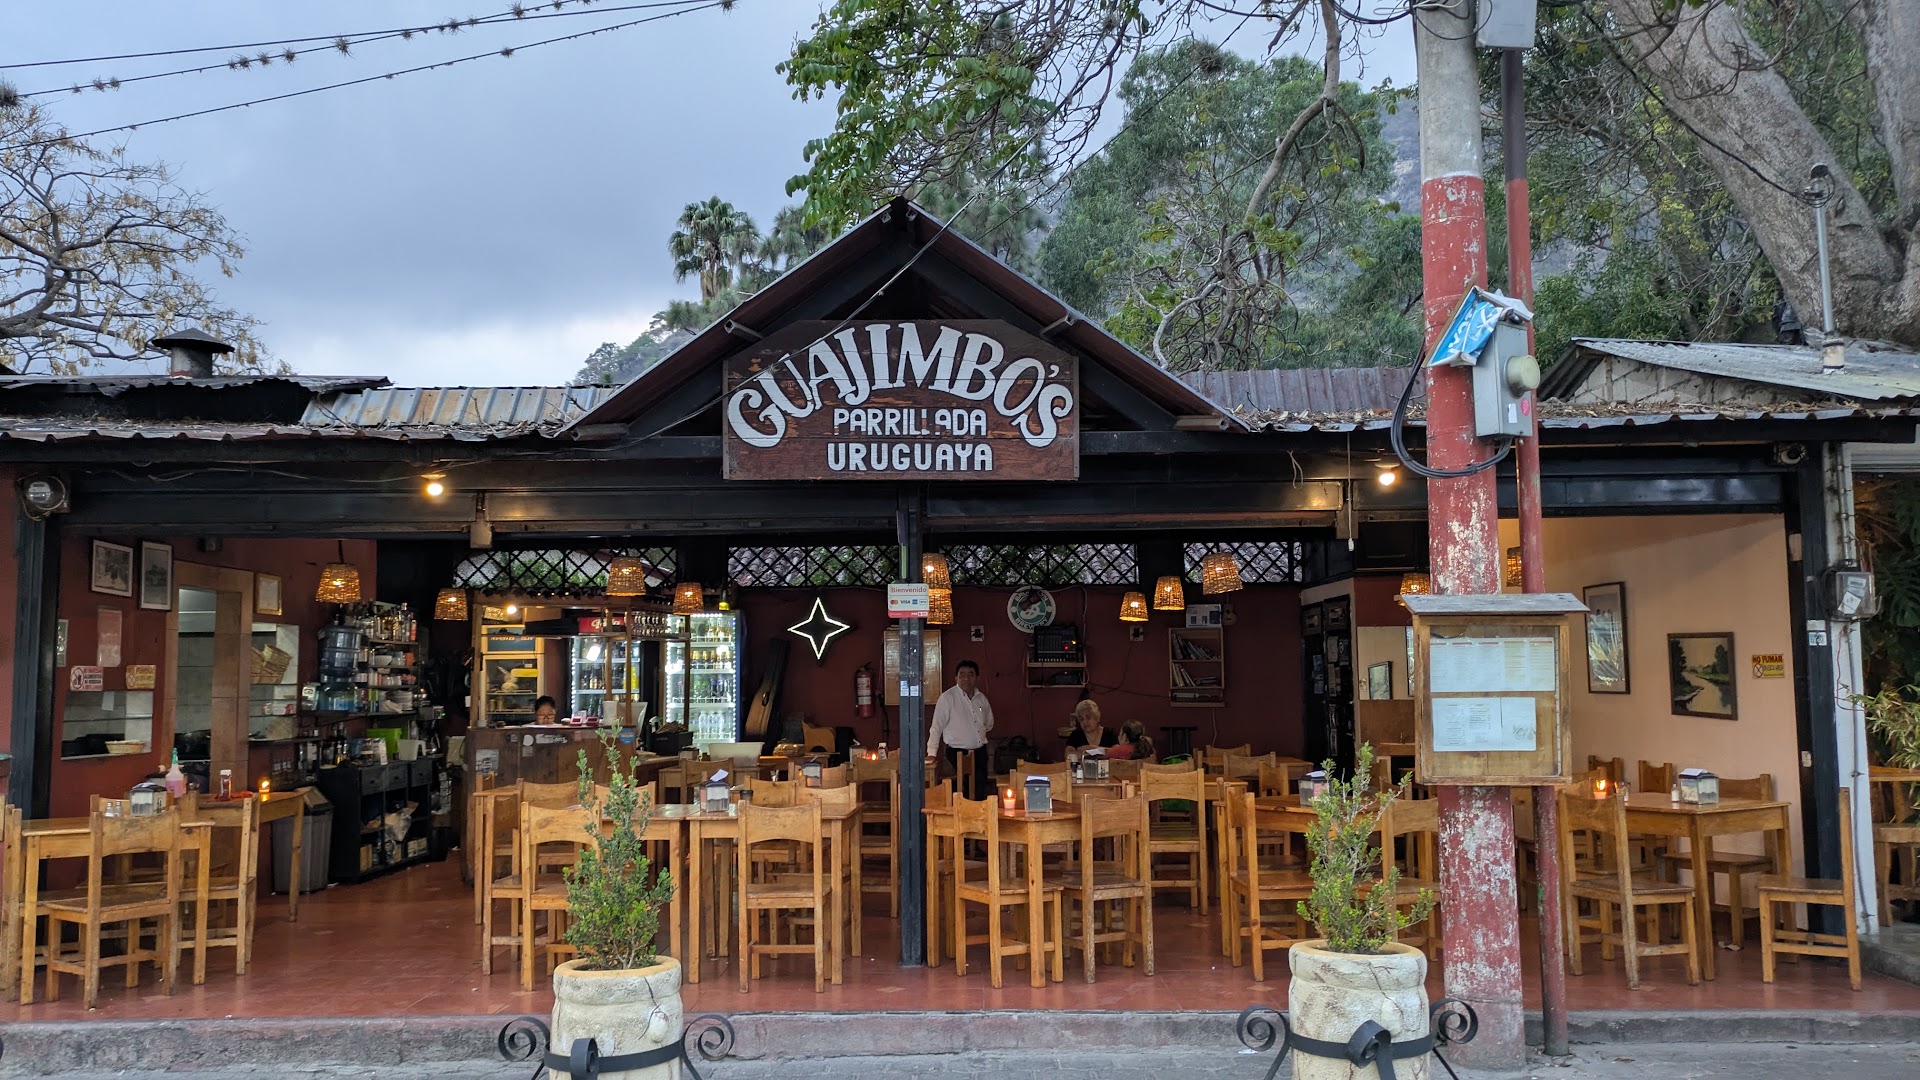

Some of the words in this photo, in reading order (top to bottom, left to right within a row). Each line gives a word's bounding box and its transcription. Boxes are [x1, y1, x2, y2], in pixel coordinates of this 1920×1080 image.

[727, 322, 1074, 448] GUAJIMBO'S
[827, 442, 993, 471] URUGUAYA
[890, 586, 927, 594] Bienvenido
